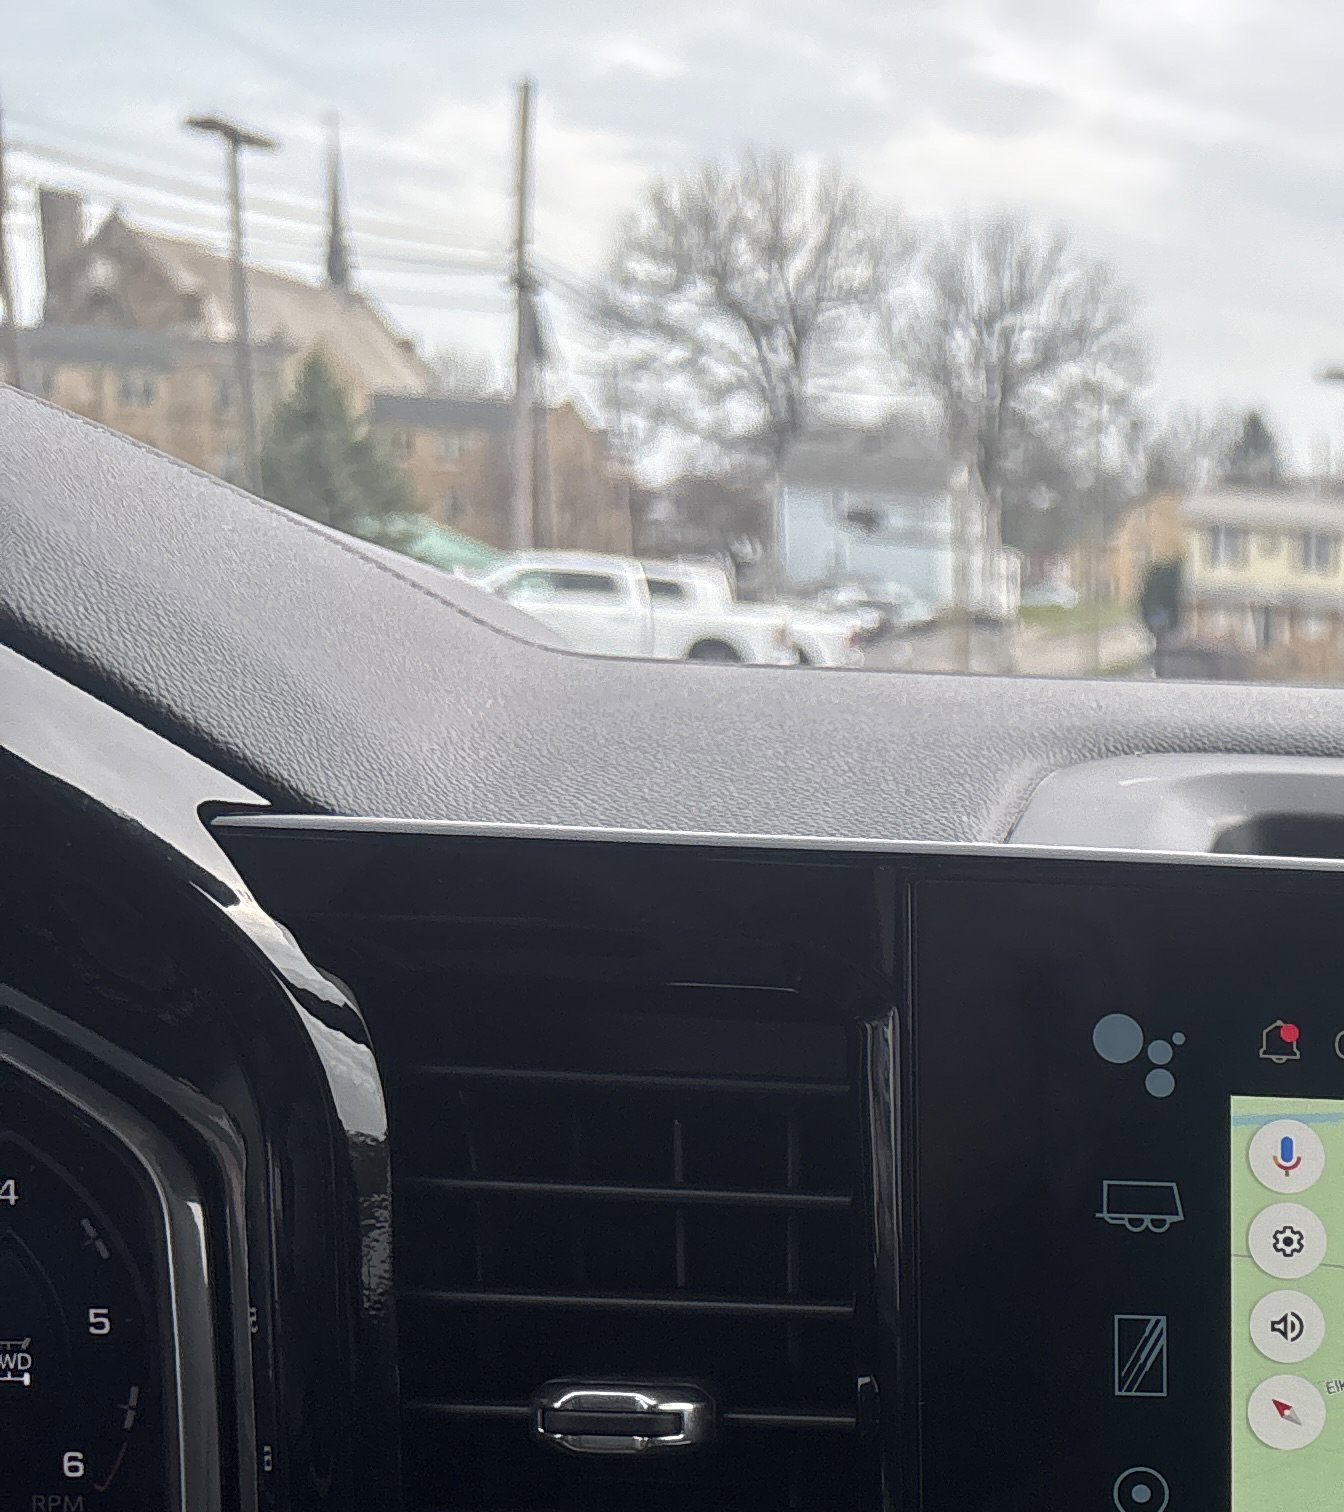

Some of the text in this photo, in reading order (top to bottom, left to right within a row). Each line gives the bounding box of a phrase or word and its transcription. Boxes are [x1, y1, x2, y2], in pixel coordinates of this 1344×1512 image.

[0, 1179, 19, 1206] 4
[88, 1308, 111, 1335] 5
[0, 1353, 32, 1371] WD
[63, 1451, 84, 1478] 6
[31, 1494, 85, 1512] RPM
